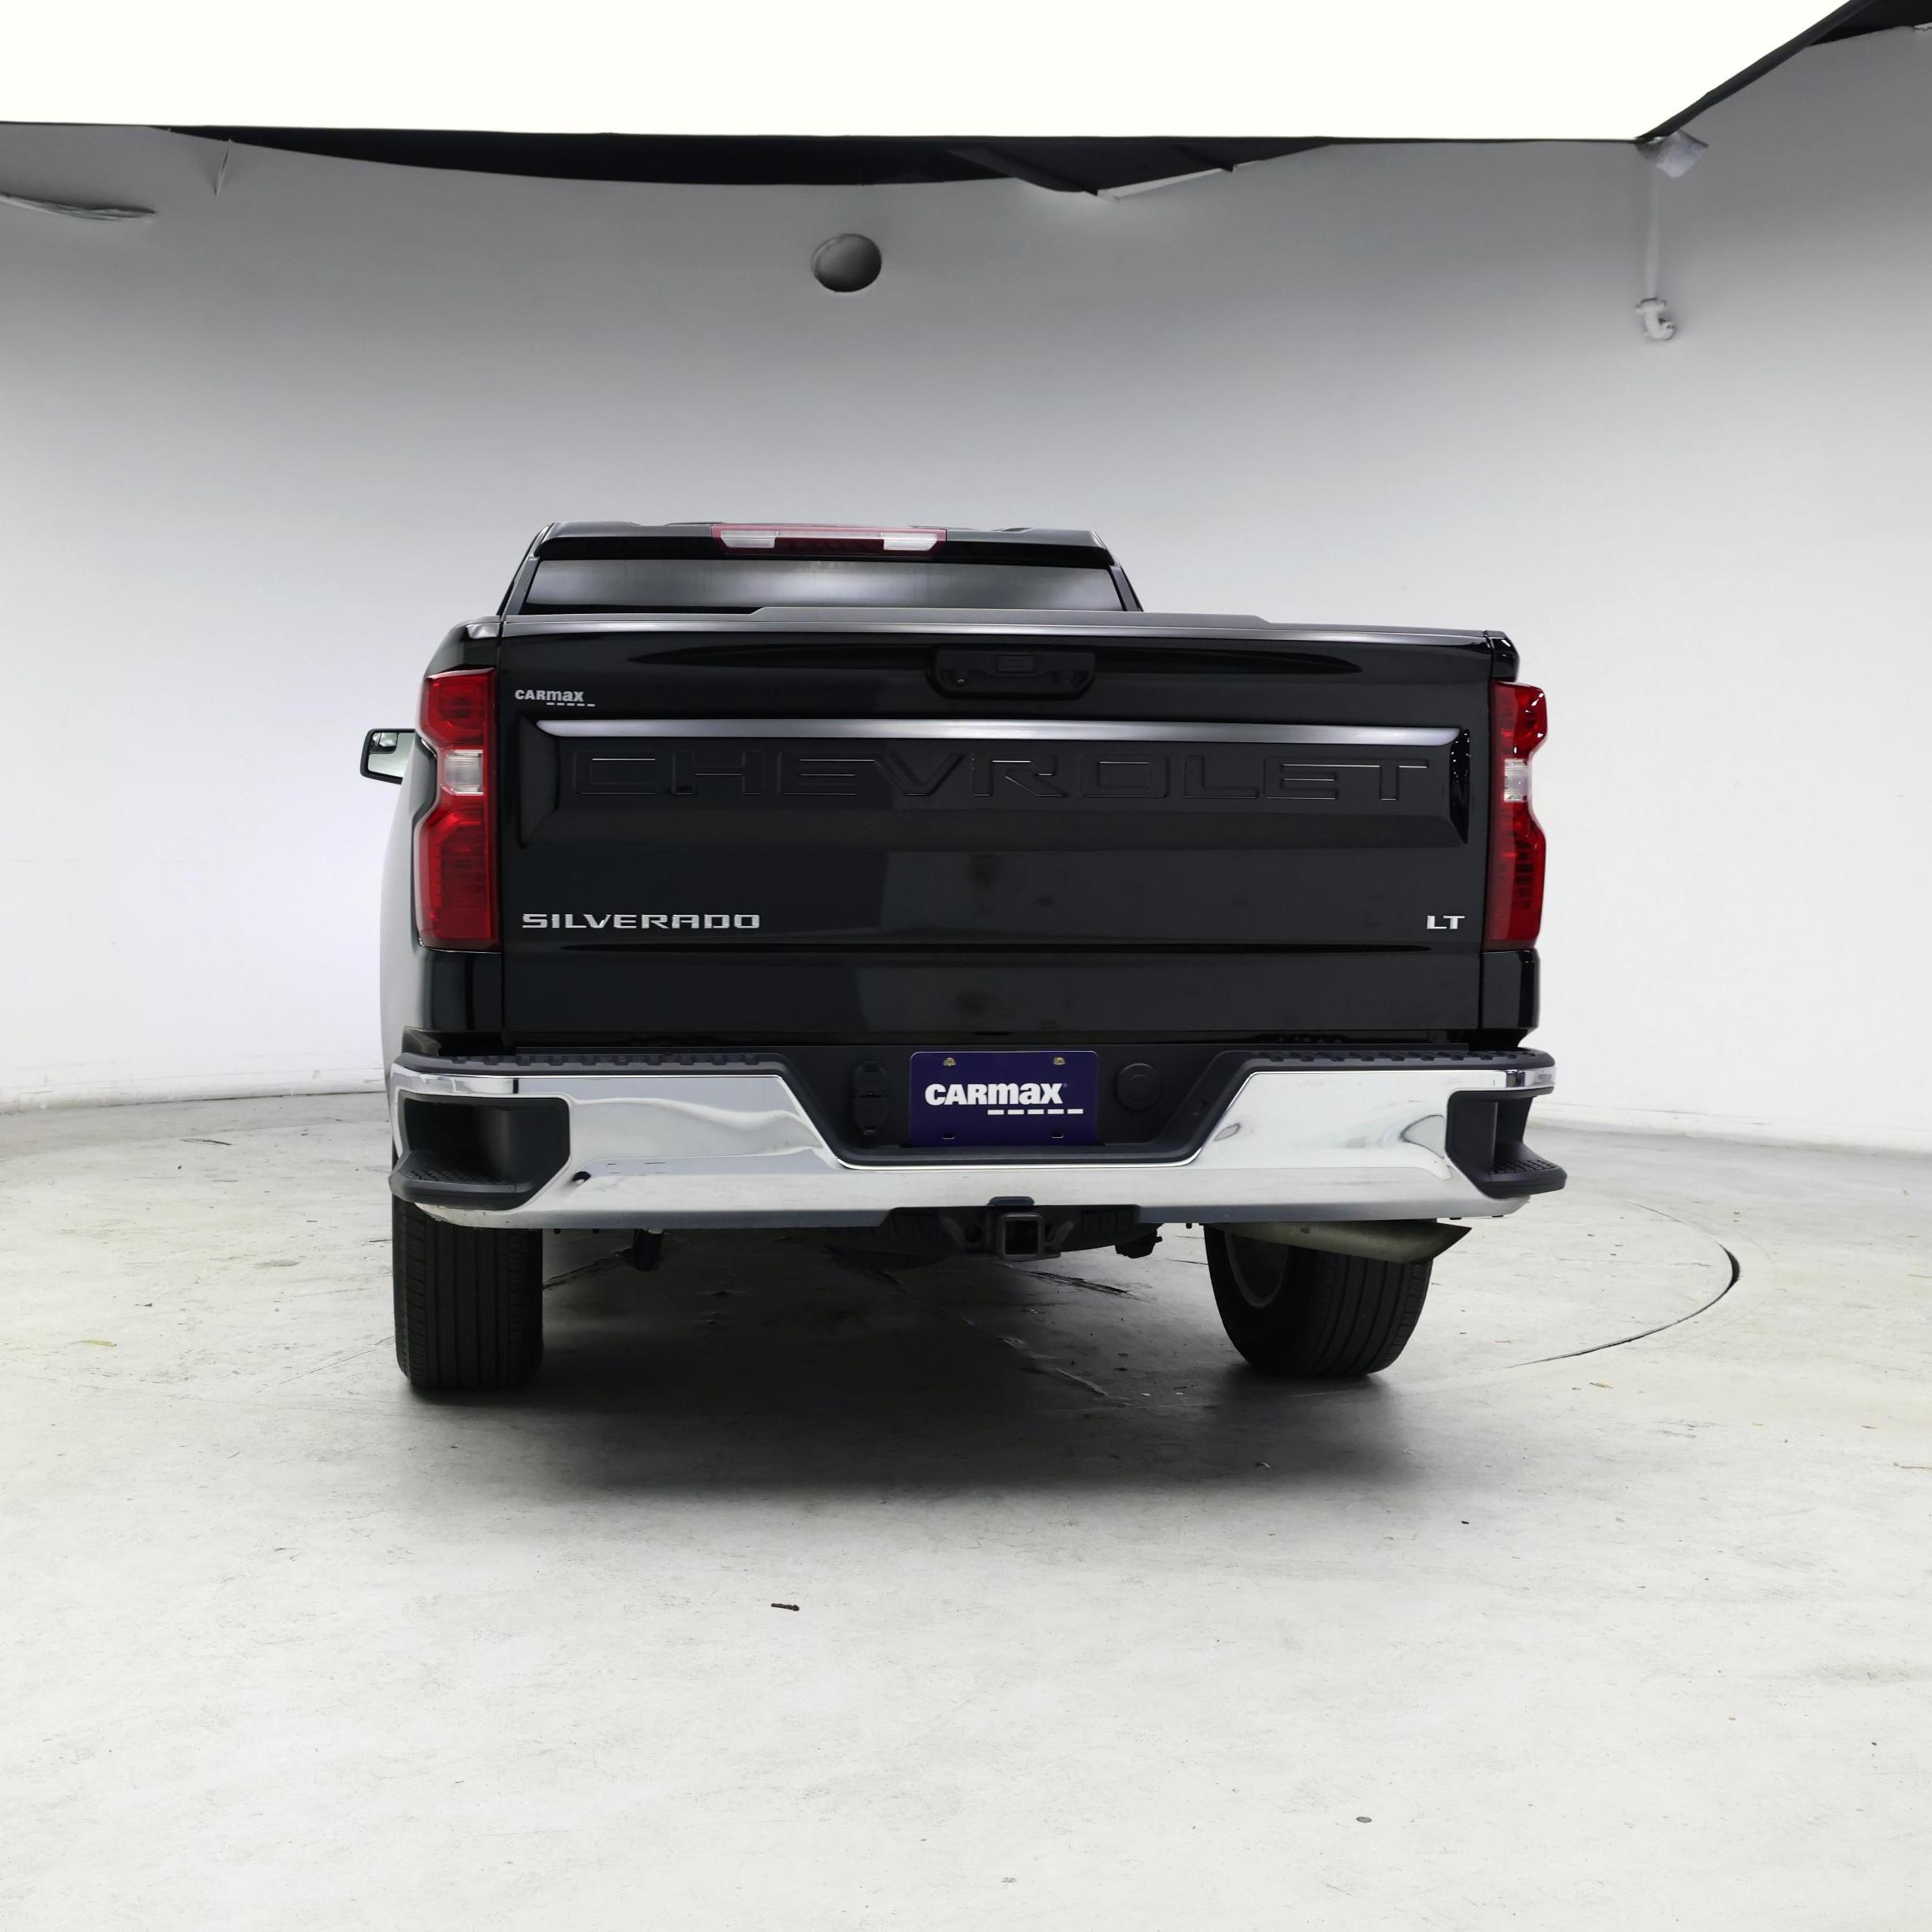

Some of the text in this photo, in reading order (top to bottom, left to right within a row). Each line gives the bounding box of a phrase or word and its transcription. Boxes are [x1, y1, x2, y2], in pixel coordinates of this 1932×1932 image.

[574, 751, 1429, 800] CHEVROLET
[522, 913, 760, 929] SILVERADO
[1427, 915, 1465, 929] LT
